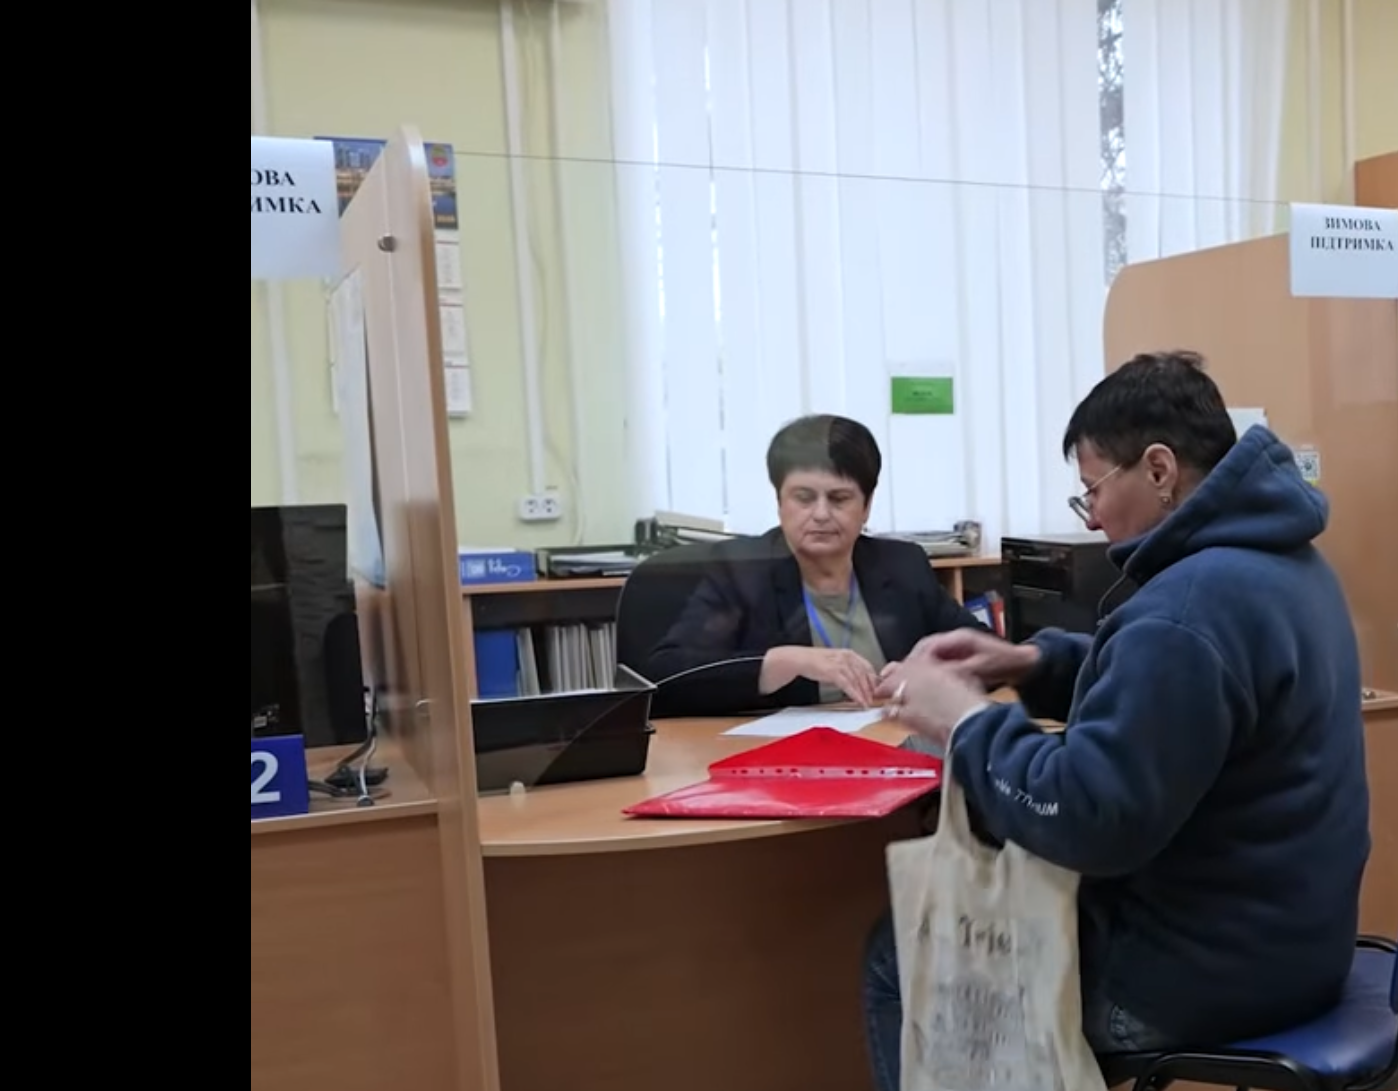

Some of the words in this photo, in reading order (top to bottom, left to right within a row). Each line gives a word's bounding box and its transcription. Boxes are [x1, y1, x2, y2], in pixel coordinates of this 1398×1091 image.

[1325, 216, 1382, 231] ЗИМОВА
[1310, 236, 1394, 251] ПІДТРИМКА
[251, 751, 281, 804] 2
